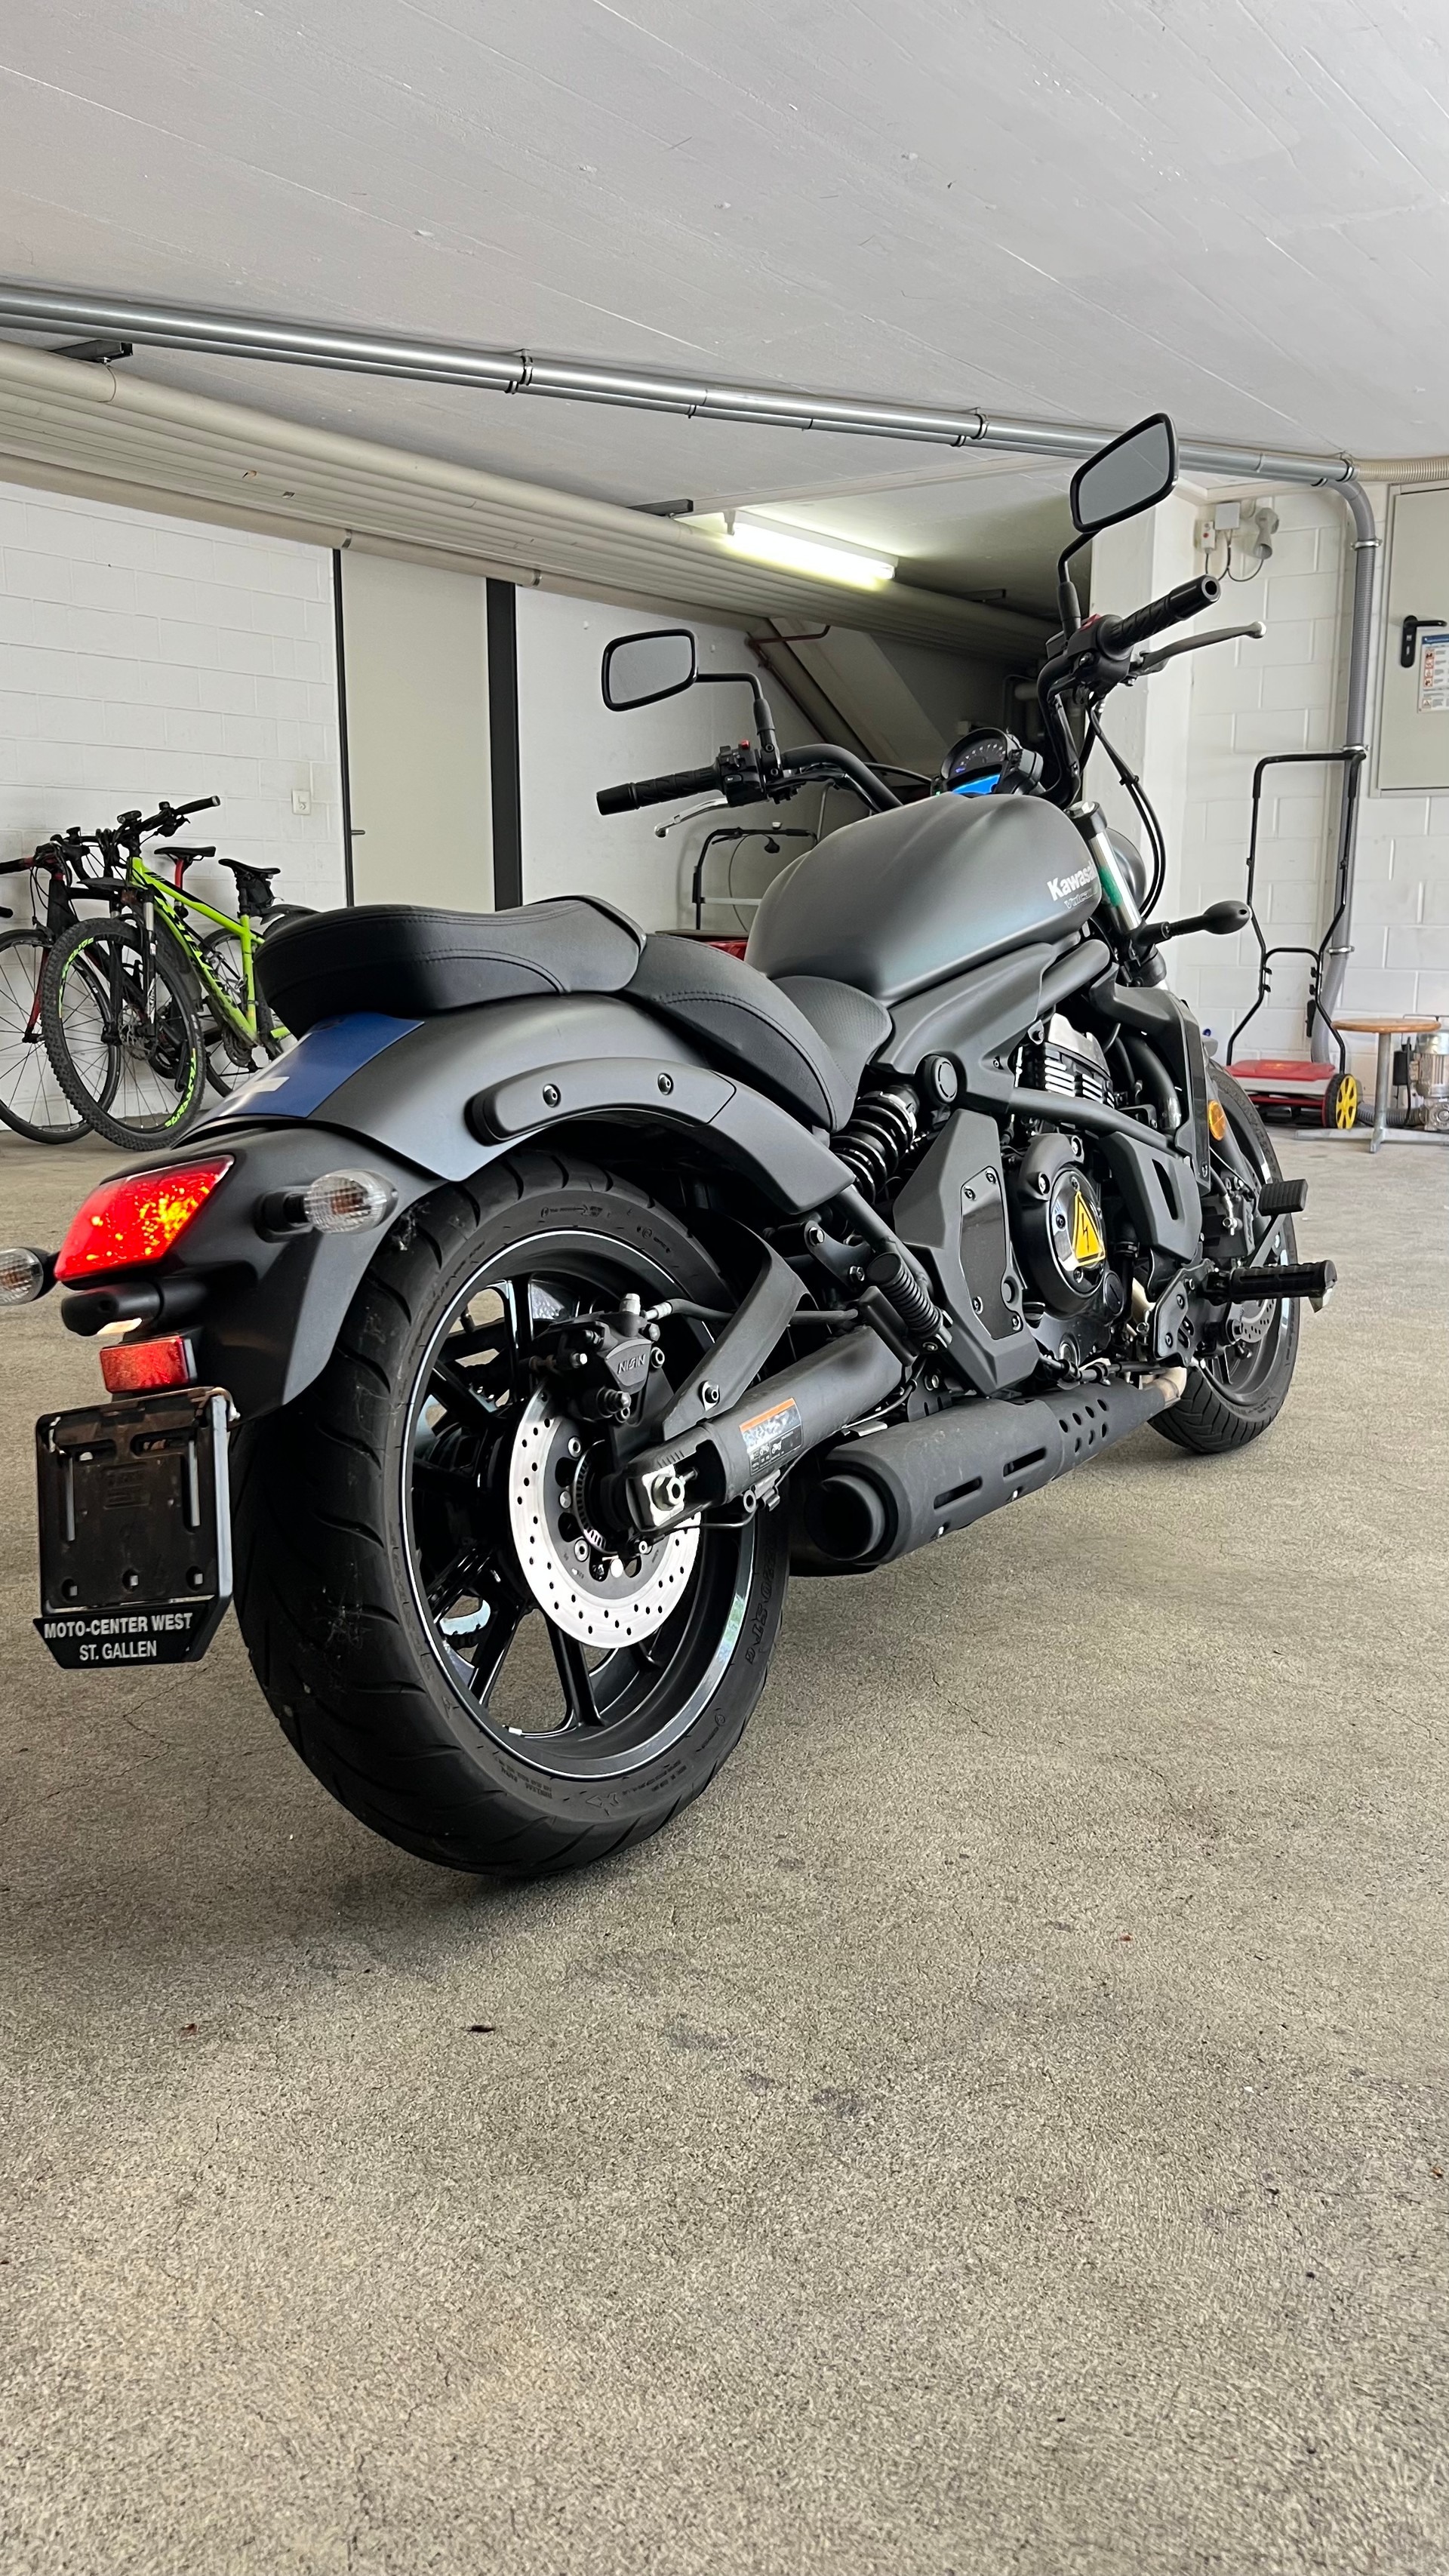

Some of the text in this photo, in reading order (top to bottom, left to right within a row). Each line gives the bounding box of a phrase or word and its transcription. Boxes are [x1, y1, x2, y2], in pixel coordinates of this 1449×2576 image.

[44, 1612, 193, 1639] MOTO-CENTER WEST
[79, 1640, 157, 1660] ST. GALLEN
